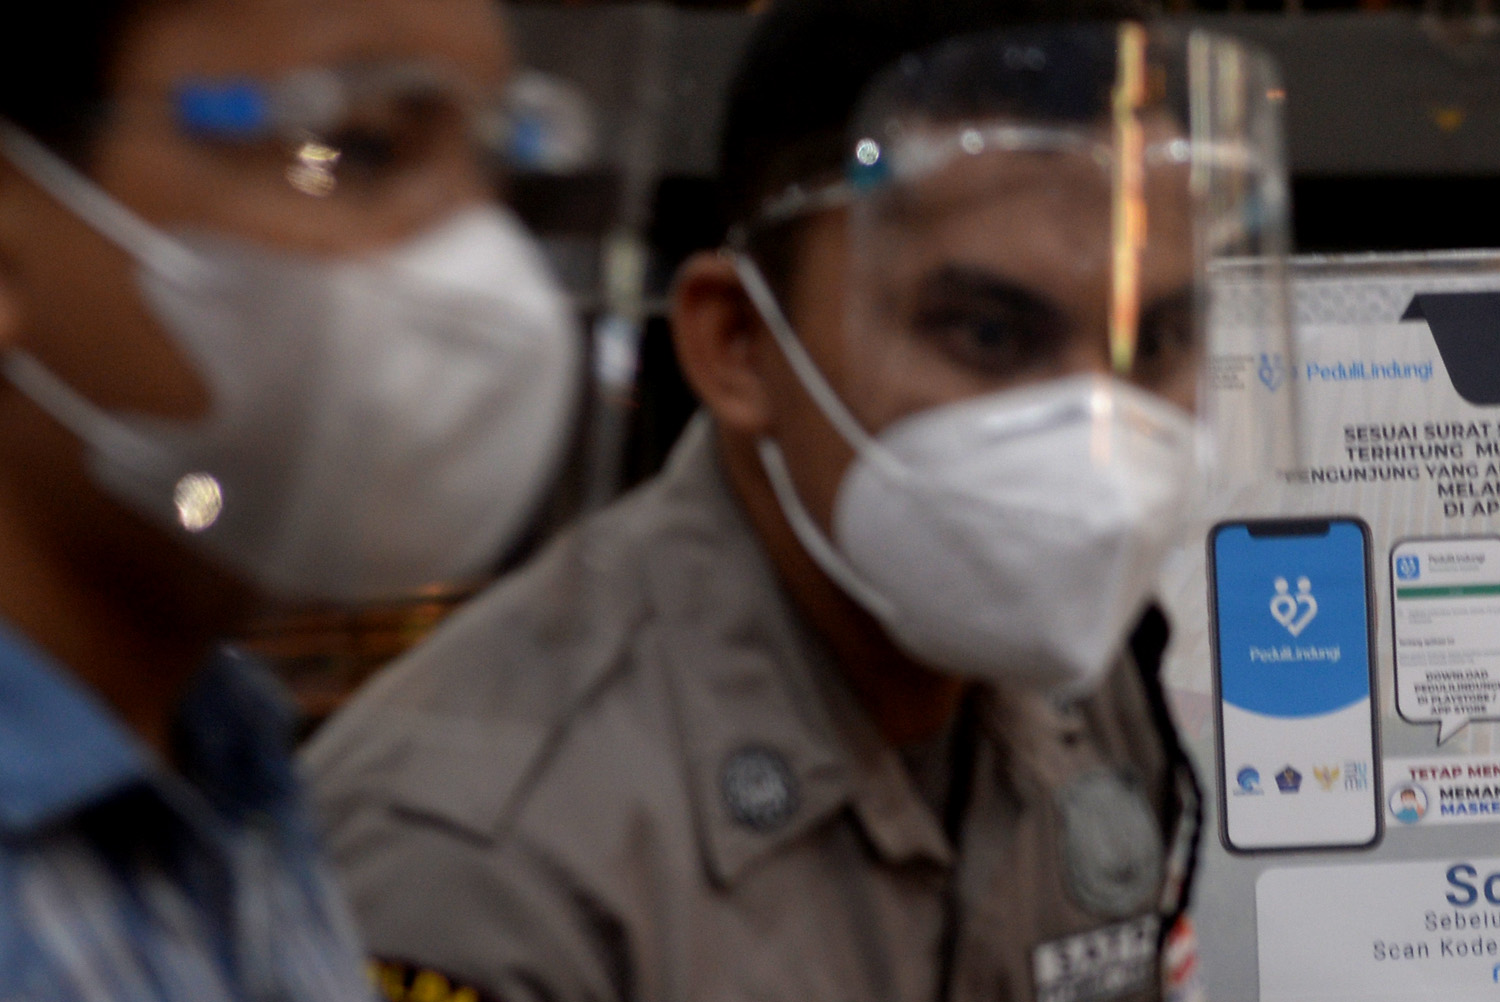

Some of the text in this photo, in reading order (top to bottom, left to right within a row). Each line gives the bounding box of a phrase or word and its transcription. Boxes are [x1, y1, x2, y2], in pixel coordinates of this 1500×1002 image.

[1306, 360, 1434, 382] PeduliLindungi
[1344, 424, 1418, 443] SESUAI
[1424, 422, 1492, 441] SURAT
[1347, 443, 1463, 462] TERHITUNG
[1426, 464, 1479, 480] YANG
[1443, 500, 1465, 518] DI
[1409, 765, 1462, 781] TETAP
[1373, 940, 1430, 961] Scan
[1440, 936, 1498, 957] Kode
